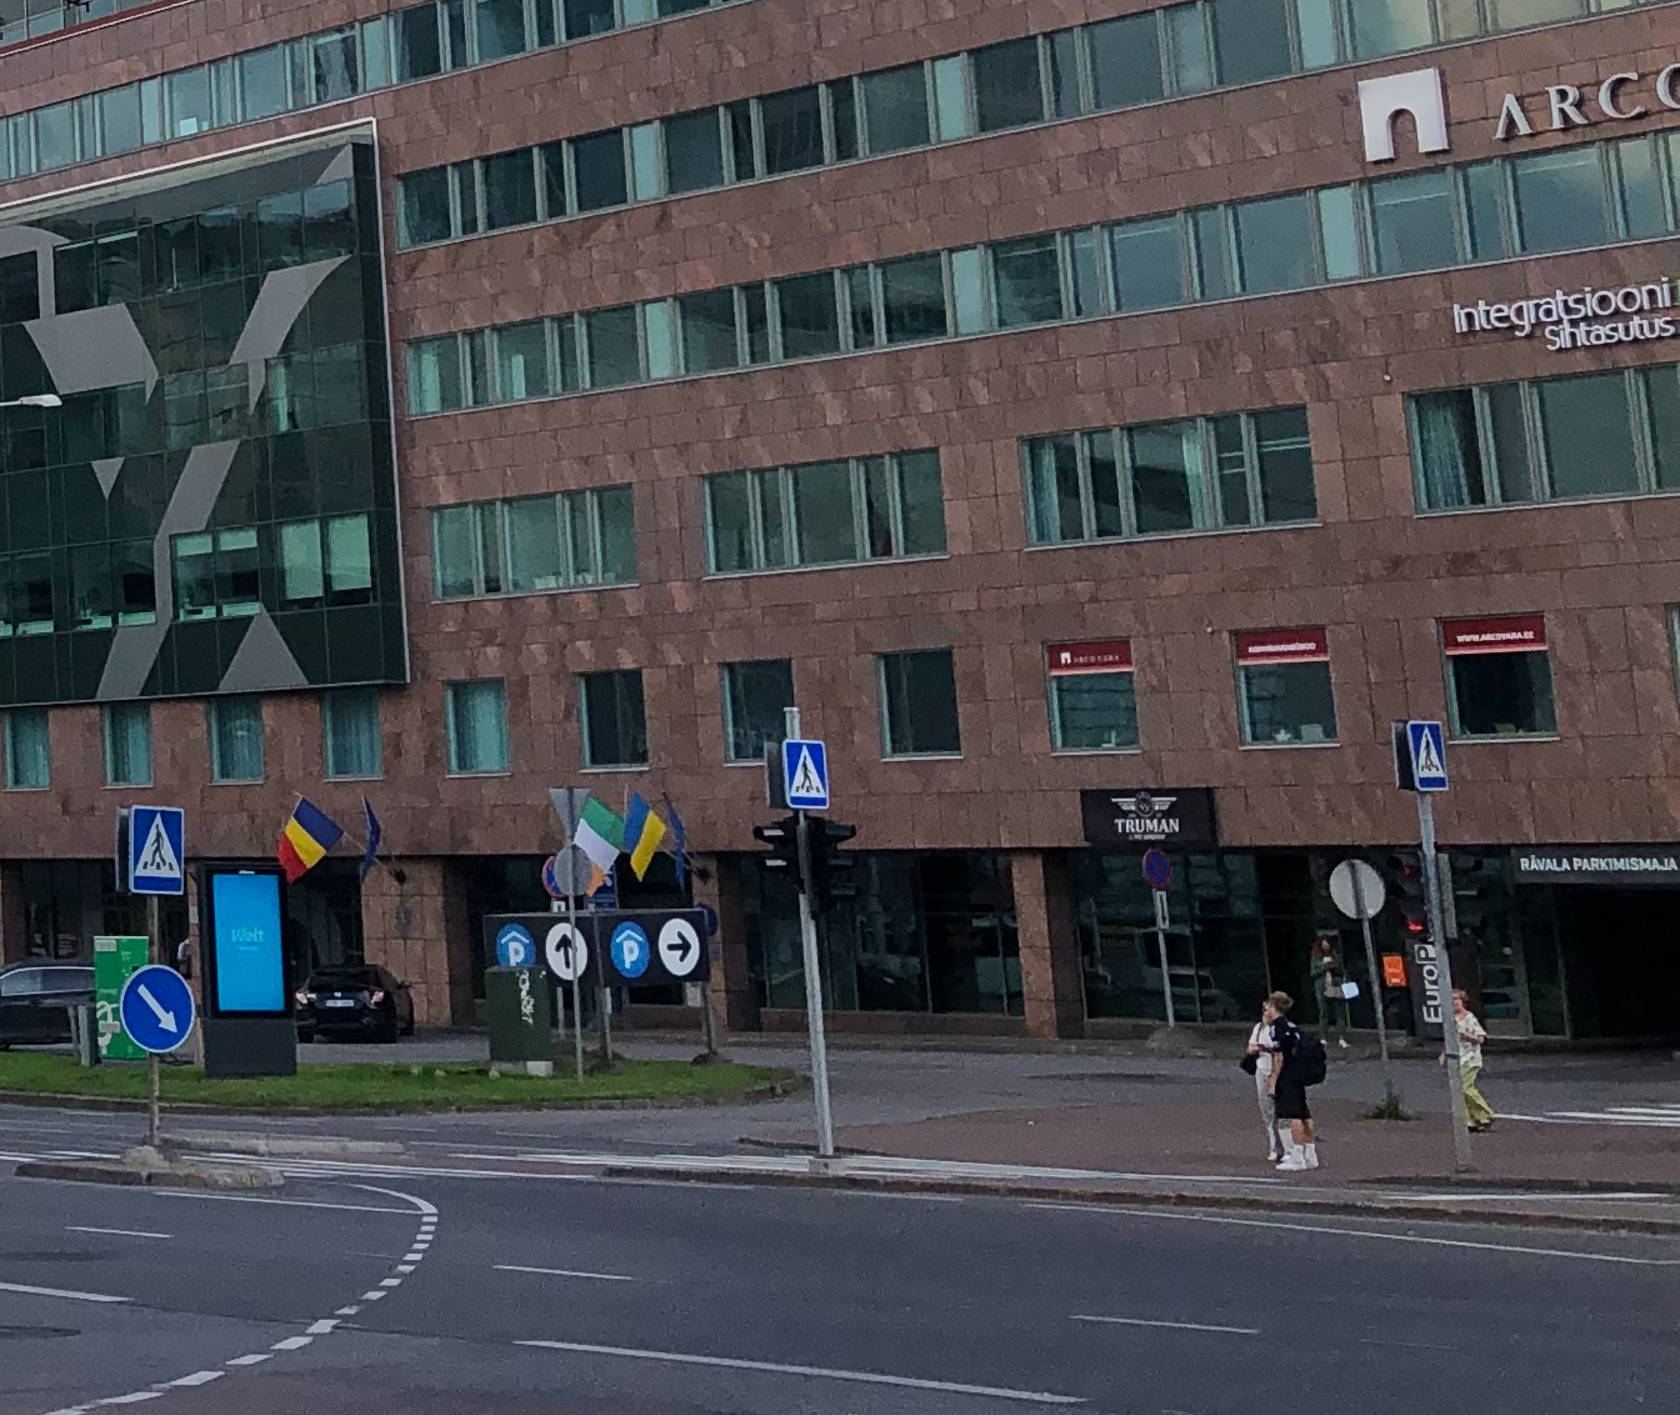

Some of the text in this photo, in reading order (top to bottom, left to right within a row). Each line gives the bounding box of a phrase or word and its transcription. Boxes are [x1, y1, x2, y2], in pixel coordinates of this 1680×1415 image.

[1453, 276, 1672, 337] Integratsiooni
[1544, 315, 1676, 351] Sihtasutus
[1114, 817, 1180, 834] TRUMAN
[1572, 857, 1679, 871] PARKIMISMAJA
[1414, 936, 1443, 1024] EuroP
